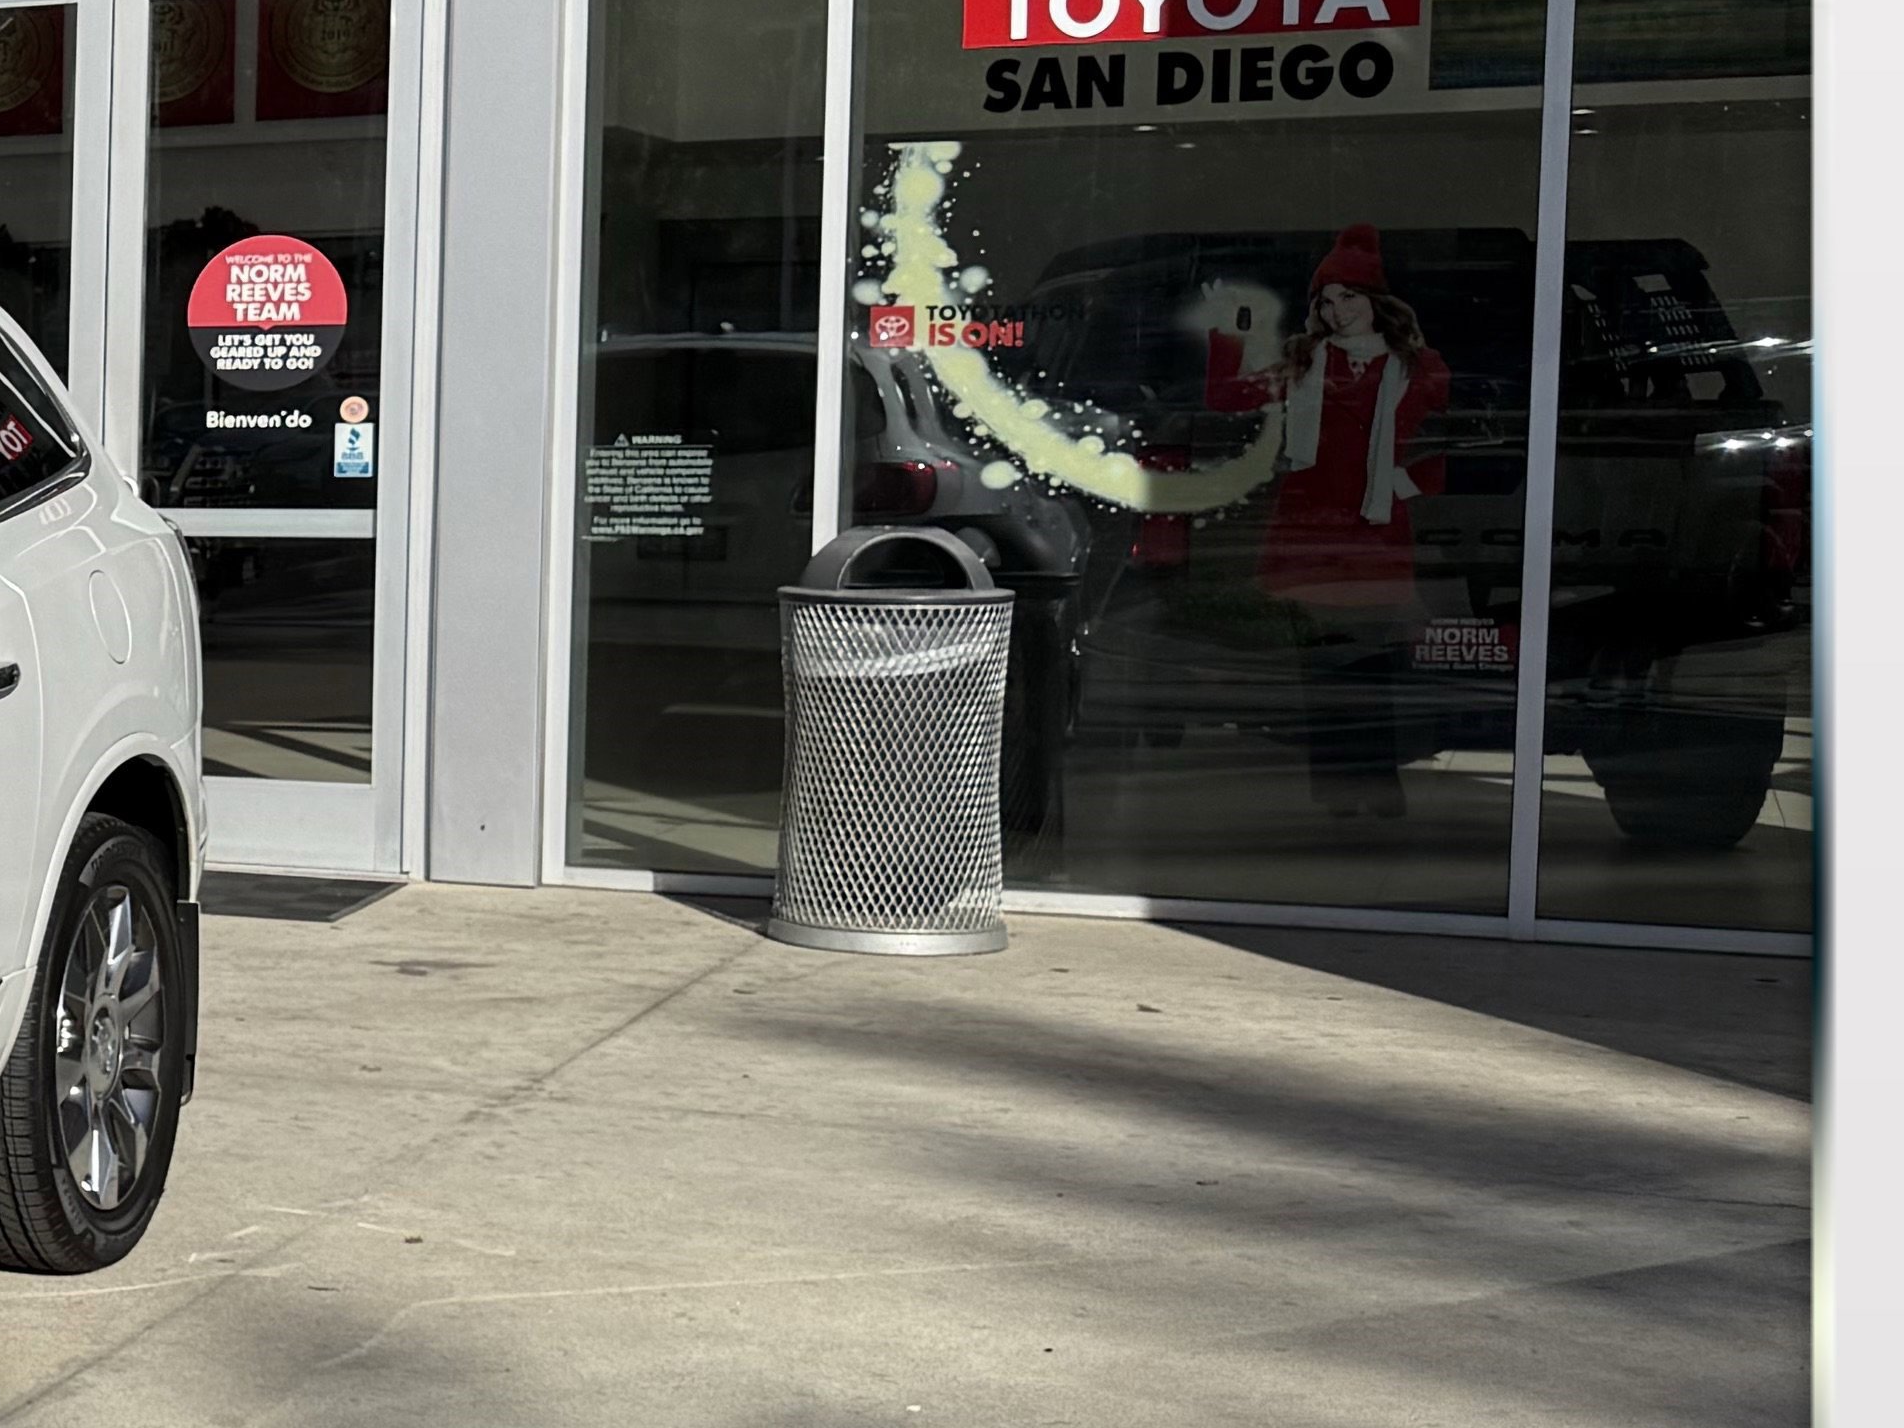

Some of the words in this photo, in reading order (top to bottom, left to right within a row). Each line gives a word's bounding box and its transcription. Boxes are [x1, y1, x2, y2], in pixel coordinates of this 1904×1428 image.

[983, 53, 1125, 114] SAN
[1156, 40, 1394, 106] DIEGO
[225, 254, 274, 264] WELCOME
[277, 253, 291, 264] TO
[294, 253, 313, 264] THE
[230, 264, 307, 283] NORM
[225, 283, 313, 303] REEVES
[232, 302, 301, 322] TEAM
[218, 334, 252, 346] LET'S
[254, 334, 282, 346] GET
[284, 333, 315, 346] YOU
[929, 323, 956, 347] IS
[961, 320, 1025, 348] ON!
[210, 346, 264, 359] GEARED
[267, 346, 288, 358] UP
[289, 345, 322, 358] AND
[216, 358, 260, 370] READY
[263, 358, 283, 370] TO
[632, 435, 681, 444] WARNING
[1424, 627, 1499, 644] NORM
[1415, 645, 1509, 662] REEVES
